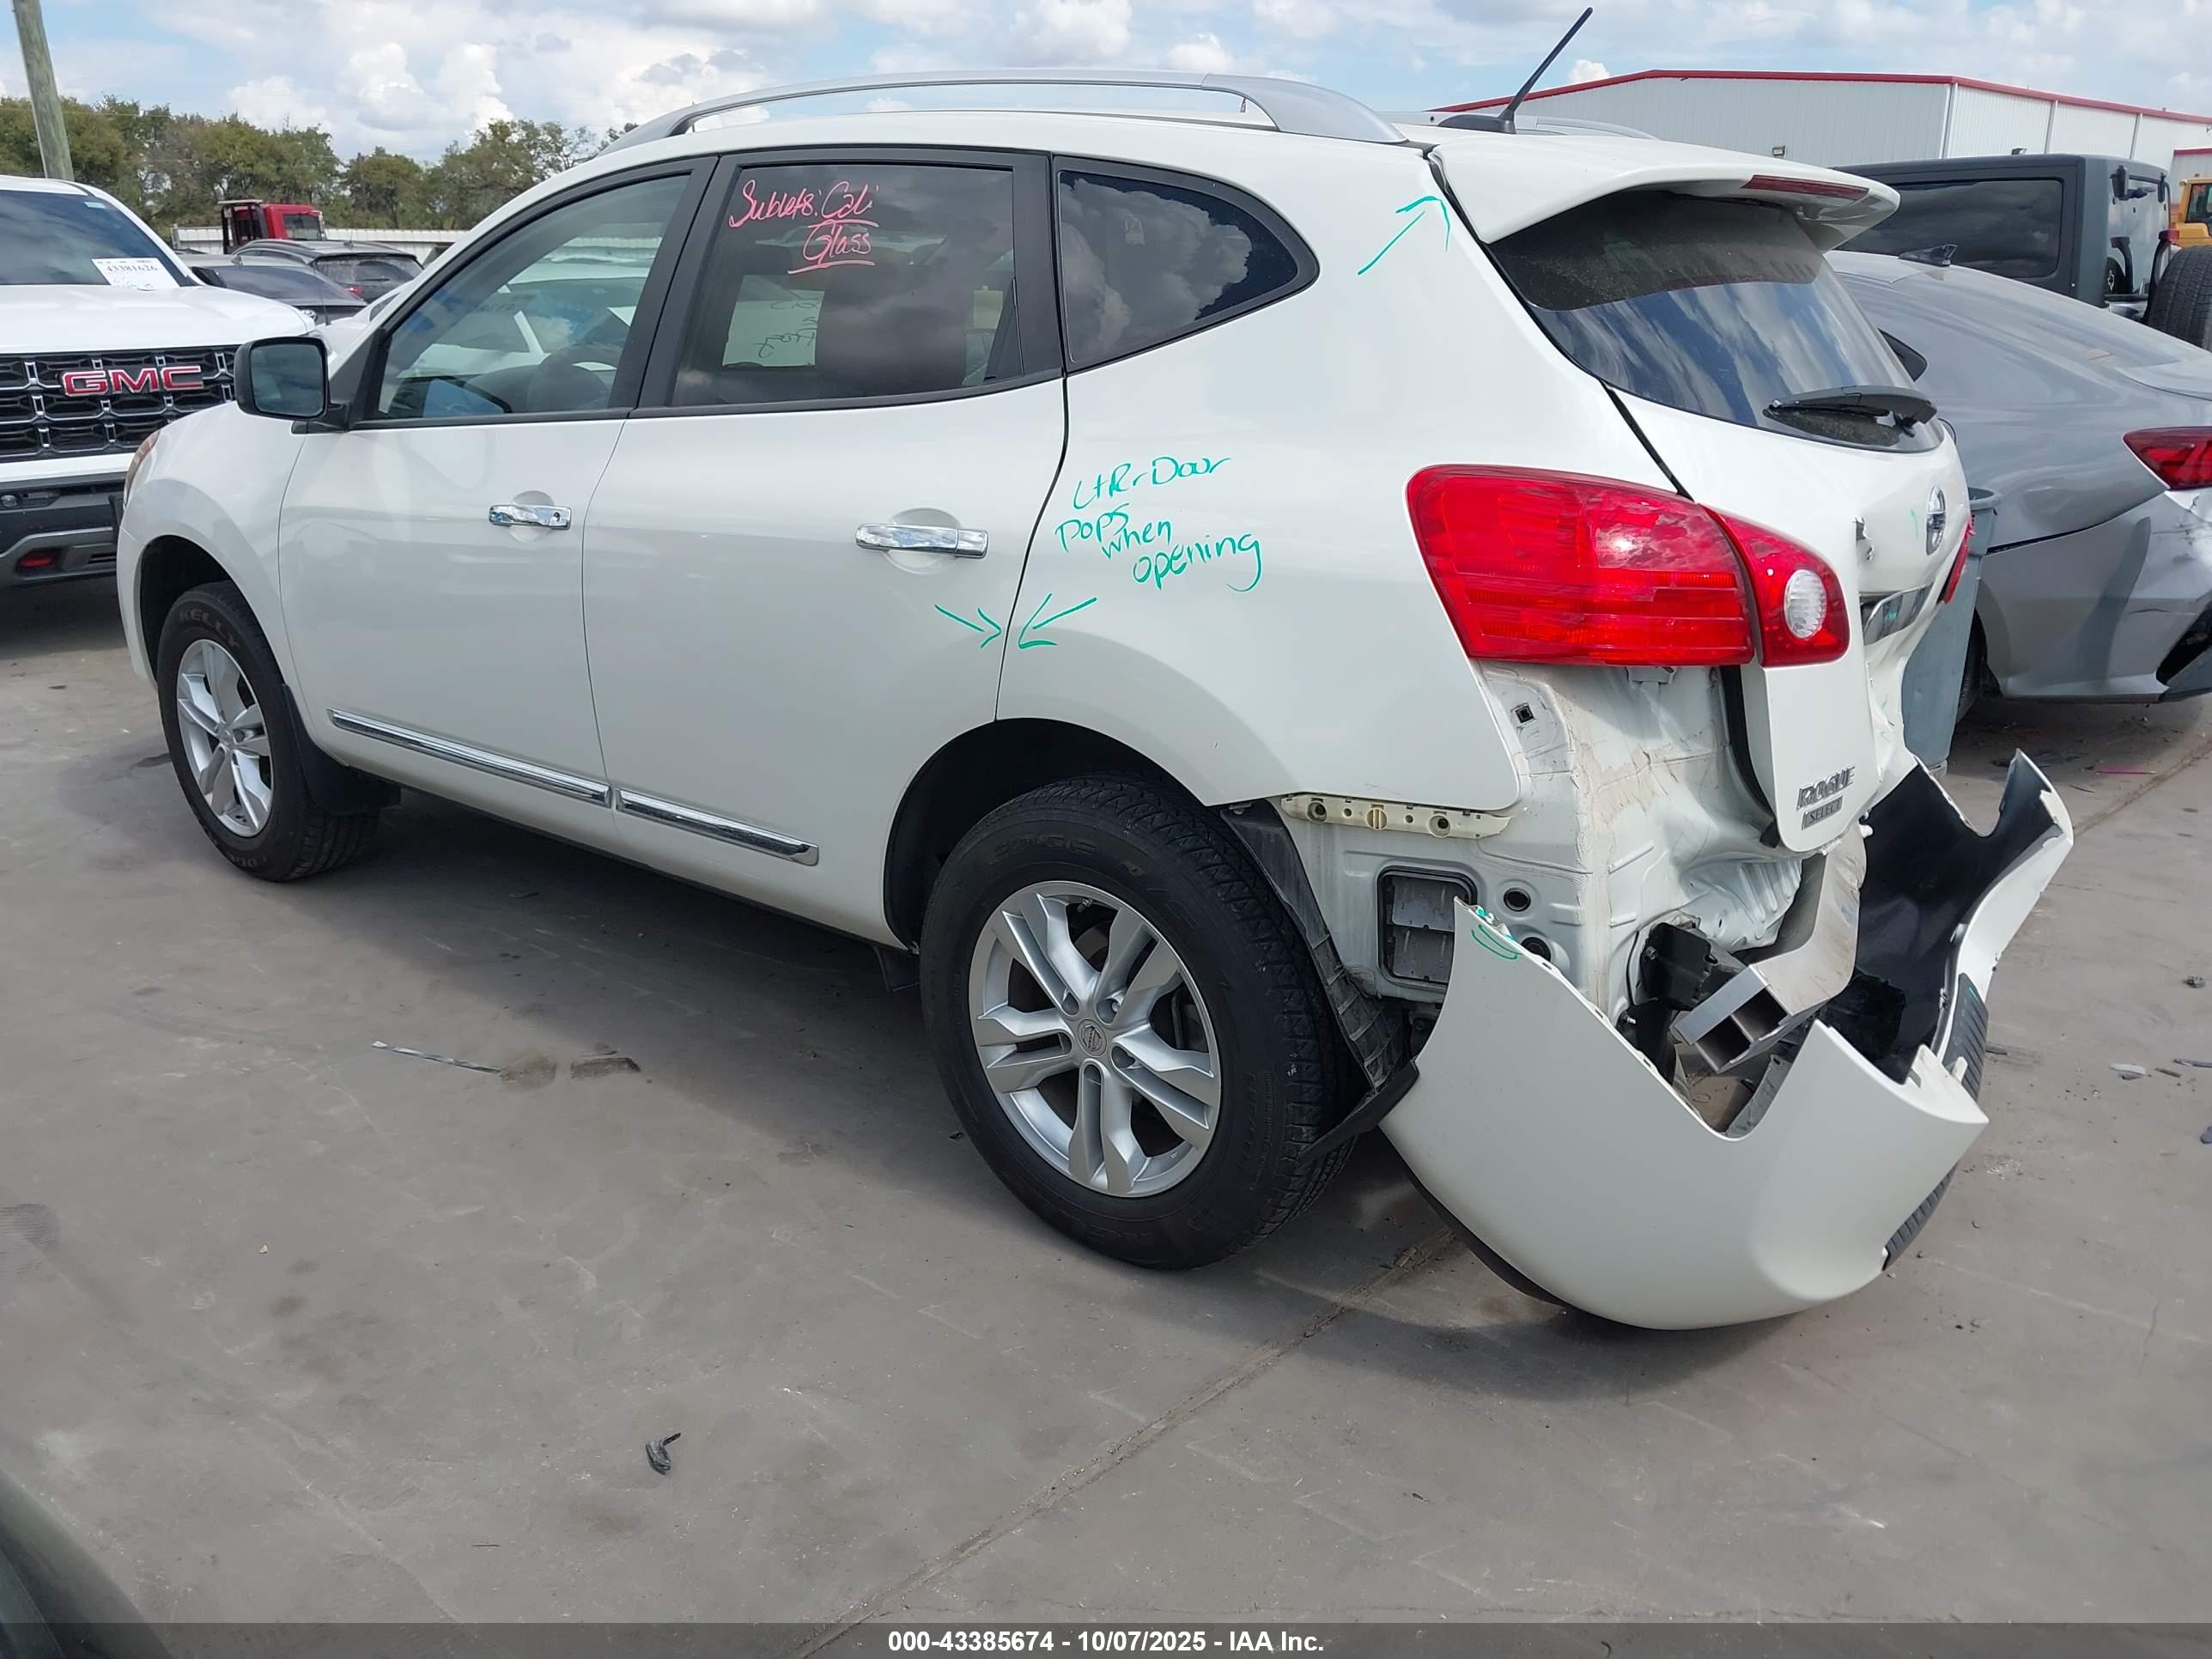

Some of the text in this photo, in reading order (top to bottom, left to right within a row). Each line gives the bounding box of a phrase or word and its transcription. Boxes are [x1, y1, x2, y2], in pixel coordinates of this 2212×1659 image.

[802, 218, 872, 265] Glass
[62, 365, 204, 398] GMC
[1101, 520, 1173, 561] when
[1132, 532, 1262, 592] opening
[1796, 765, 1856, 811] ROGUE
[1808, 799, 1842, 825] SELECT
